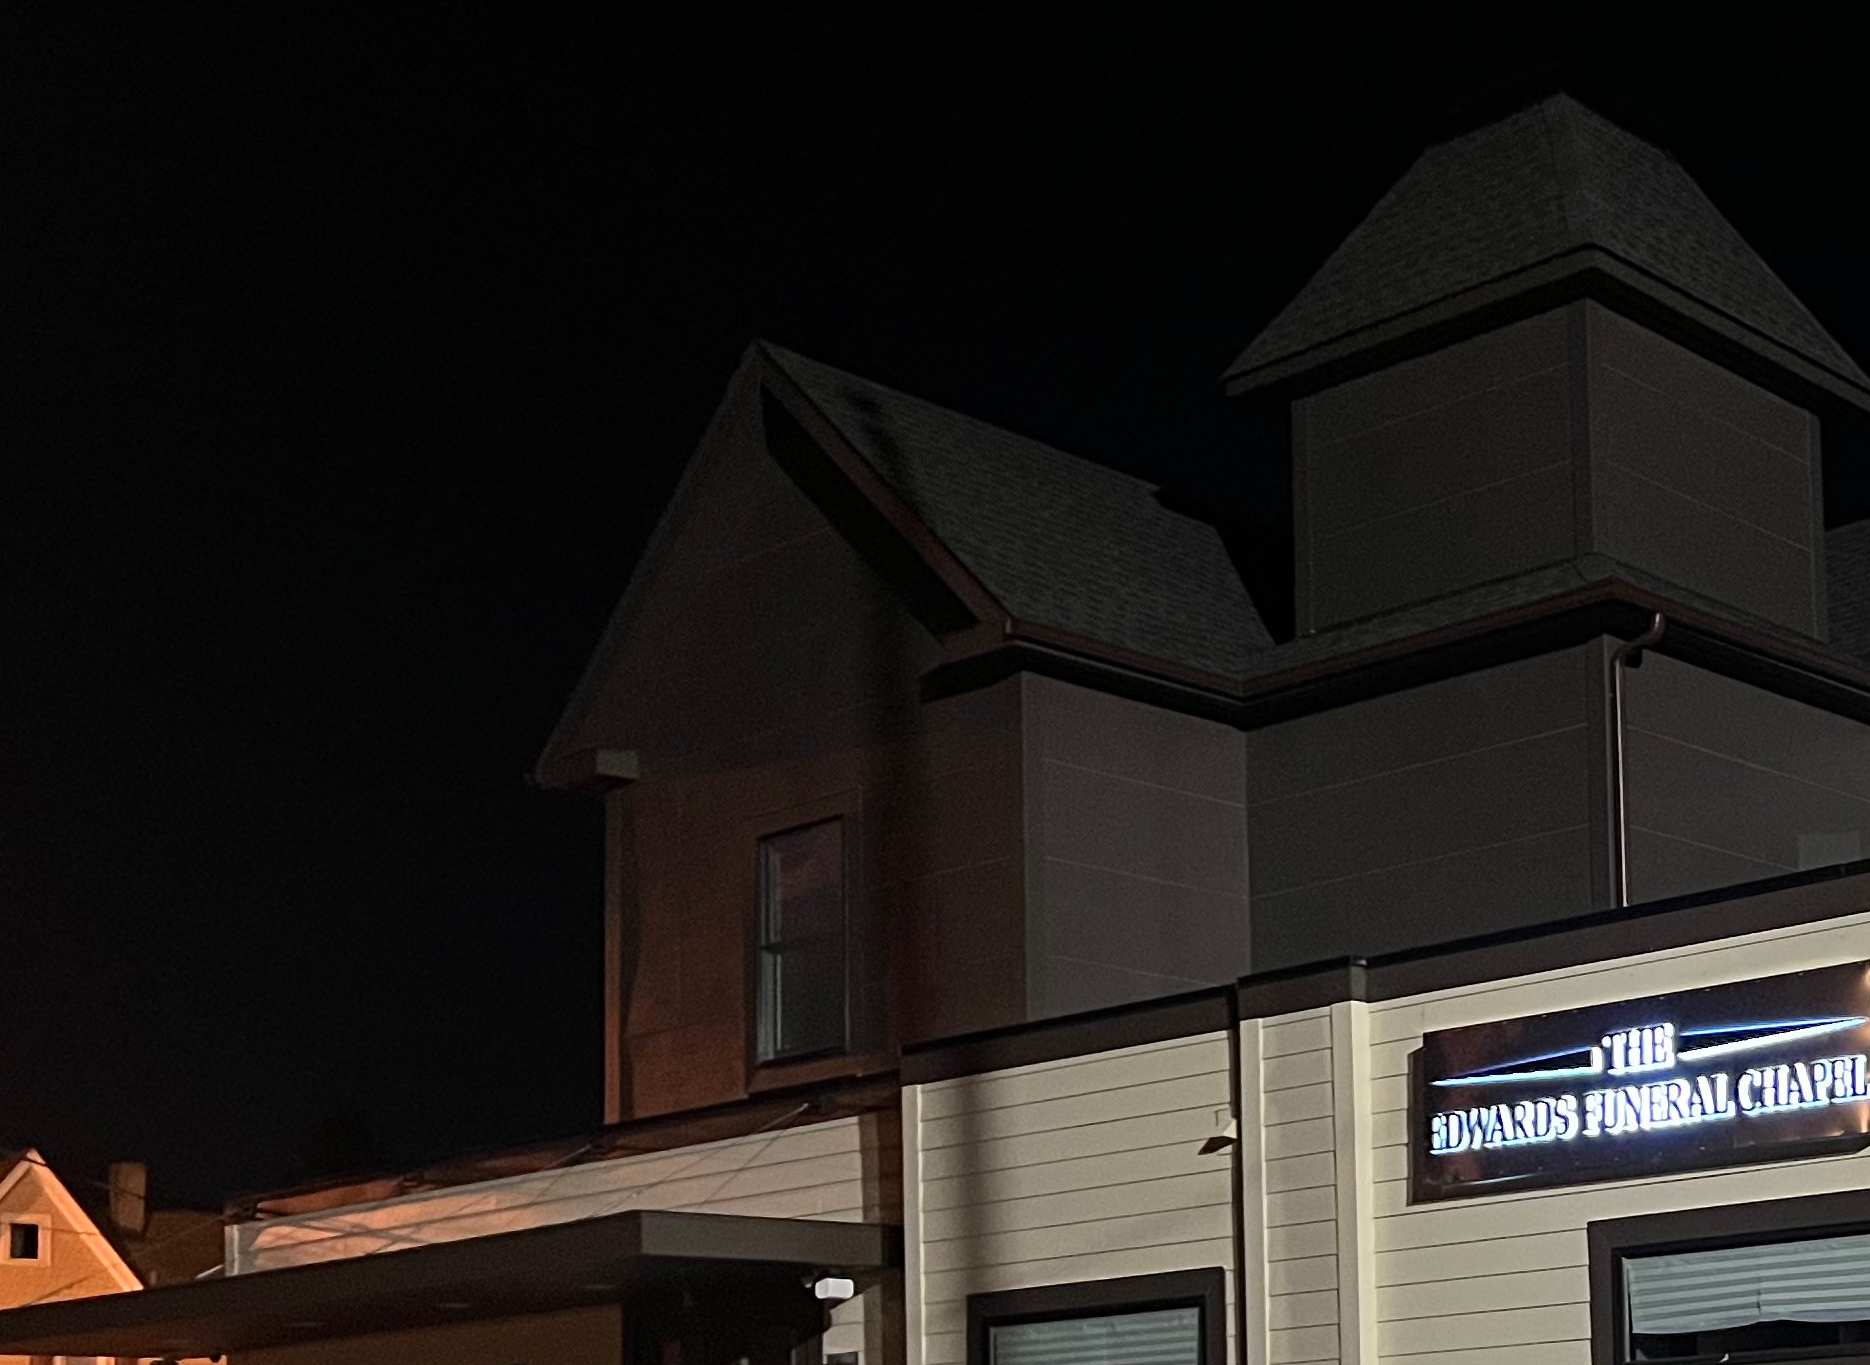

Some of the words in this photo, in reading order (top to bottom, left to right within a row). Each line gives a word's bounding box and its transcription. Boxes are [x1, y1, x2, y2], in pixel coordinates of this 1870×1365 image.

[1601, 1022, 1676, 1075] THE
[1429, 1094, 1579, 1155] EDWARDS
[1582, 1071, 1736, 1137] FUNERAL
